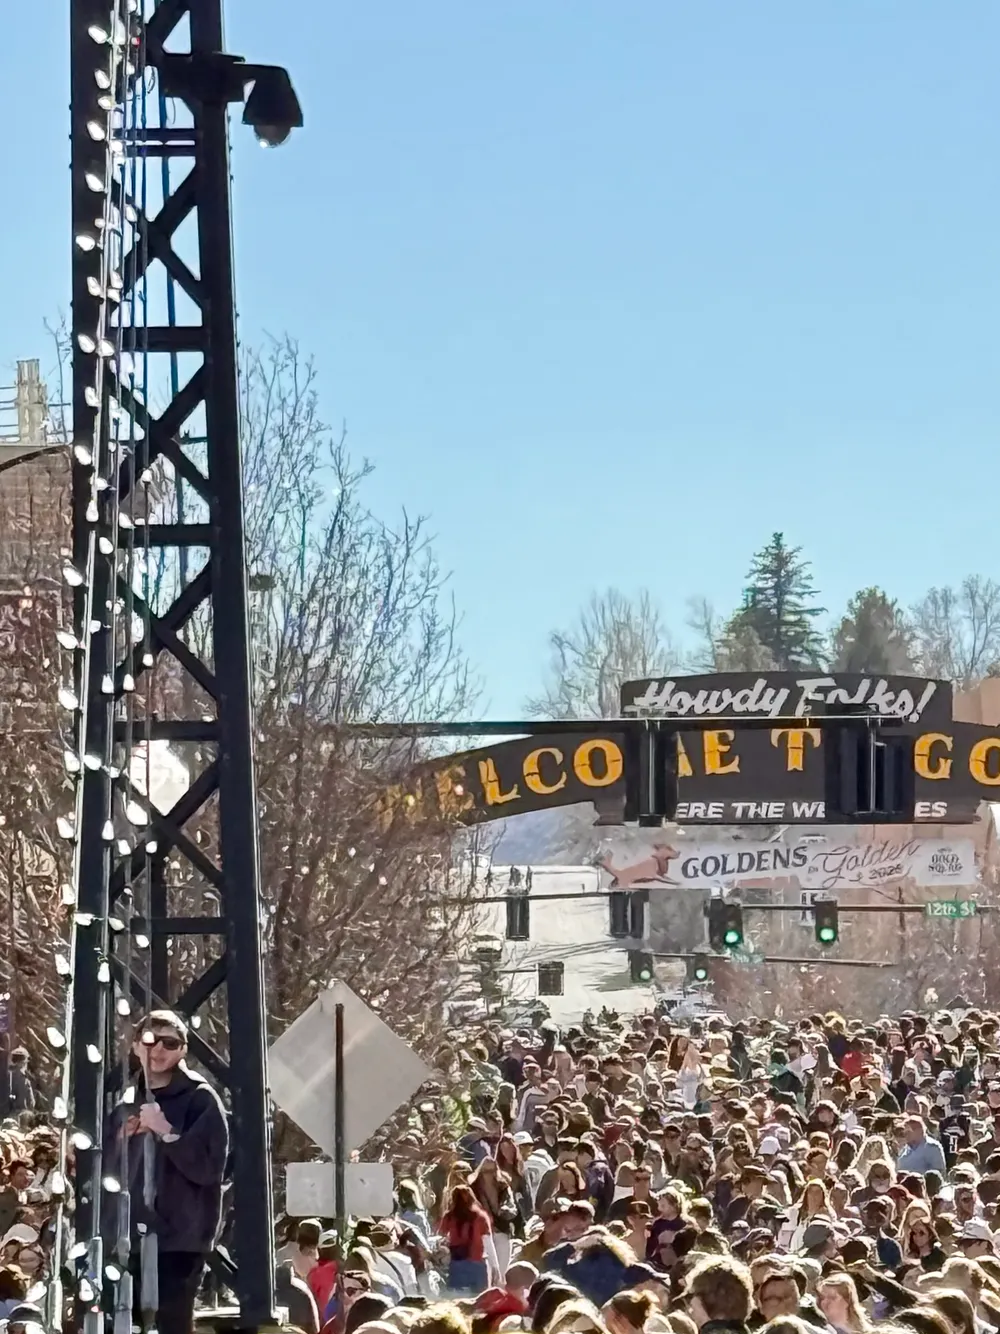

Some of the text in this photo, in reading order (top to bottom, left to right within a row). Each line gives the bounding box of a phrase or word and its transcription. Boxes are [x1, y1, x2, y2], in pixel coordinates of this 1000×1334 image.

[634, 678, 789, 717] Howdy
[732, 801, 785, 819] THE
[681, 846, 808, 879] GOLDENS
